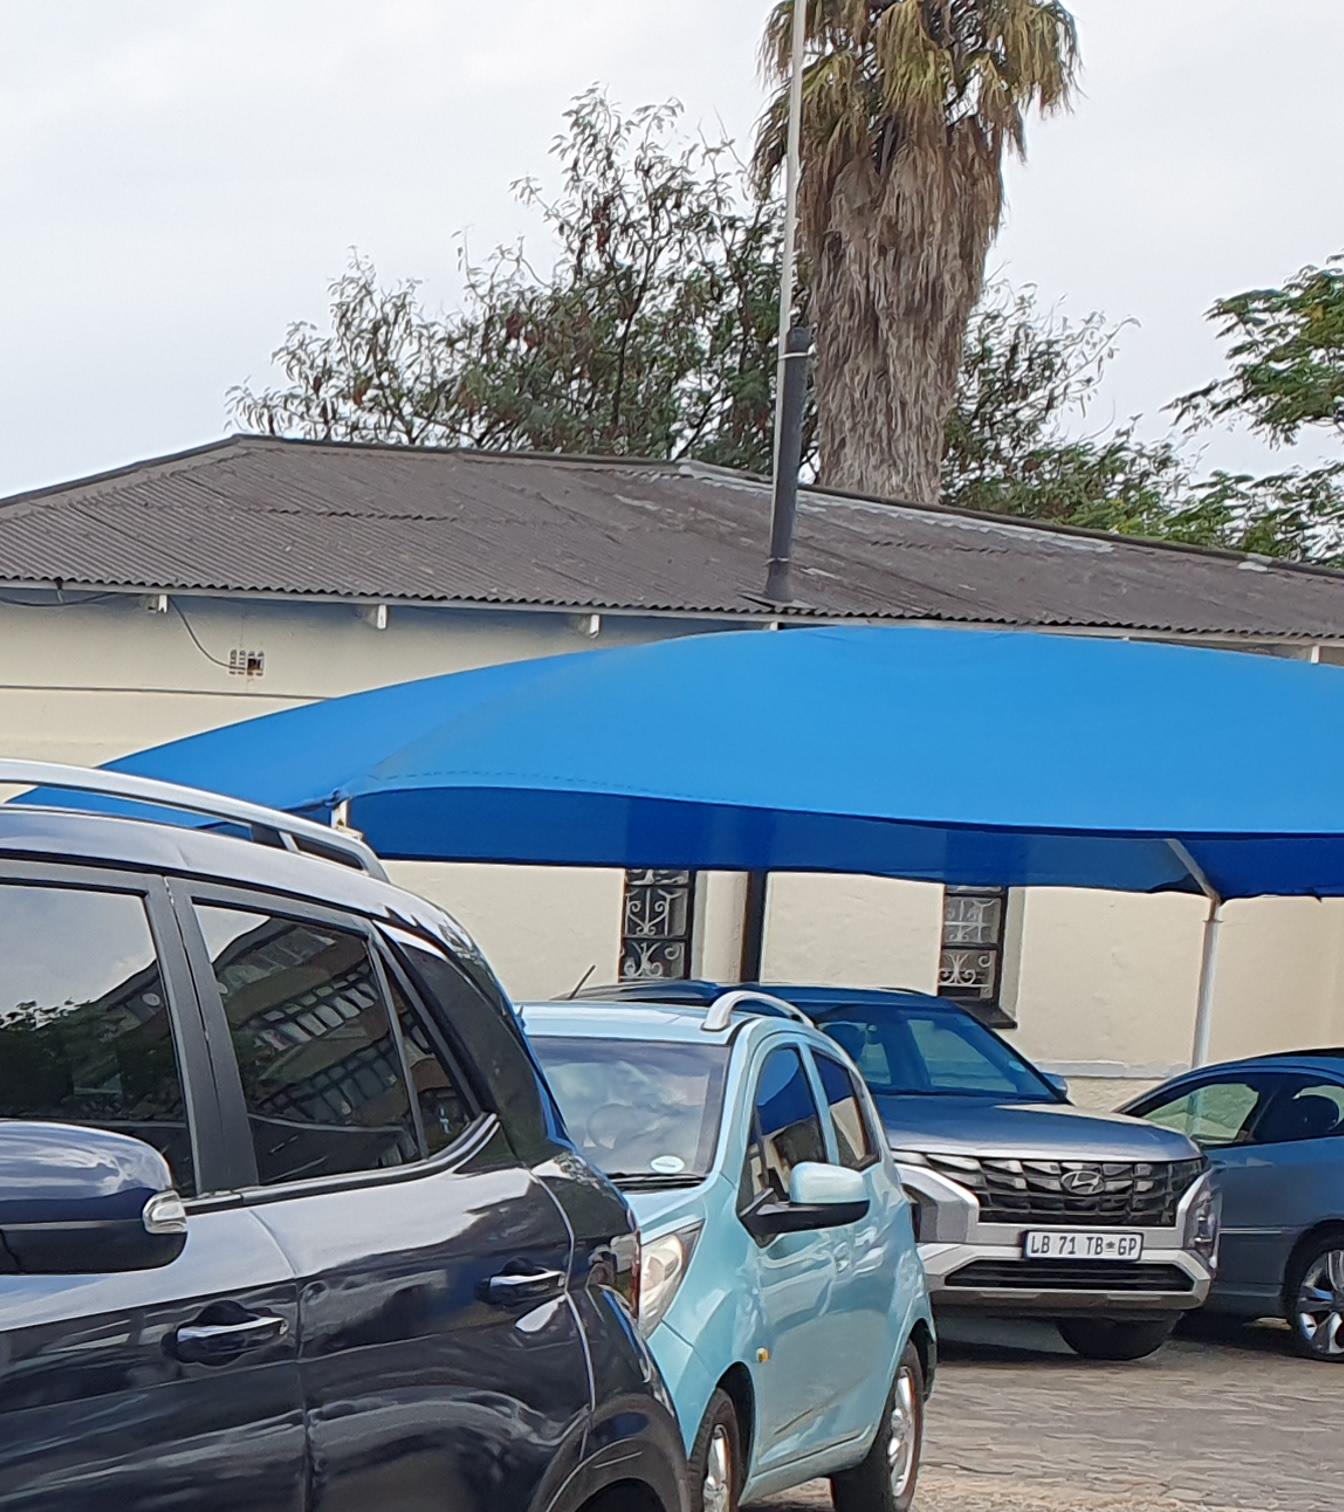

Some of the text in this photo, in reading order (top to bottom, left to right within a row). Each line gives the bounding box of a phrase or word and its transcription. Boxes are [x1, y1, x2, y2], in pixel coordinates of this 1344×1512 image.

[1030, 1235, 1138, 1257] LB 71 TB GP
